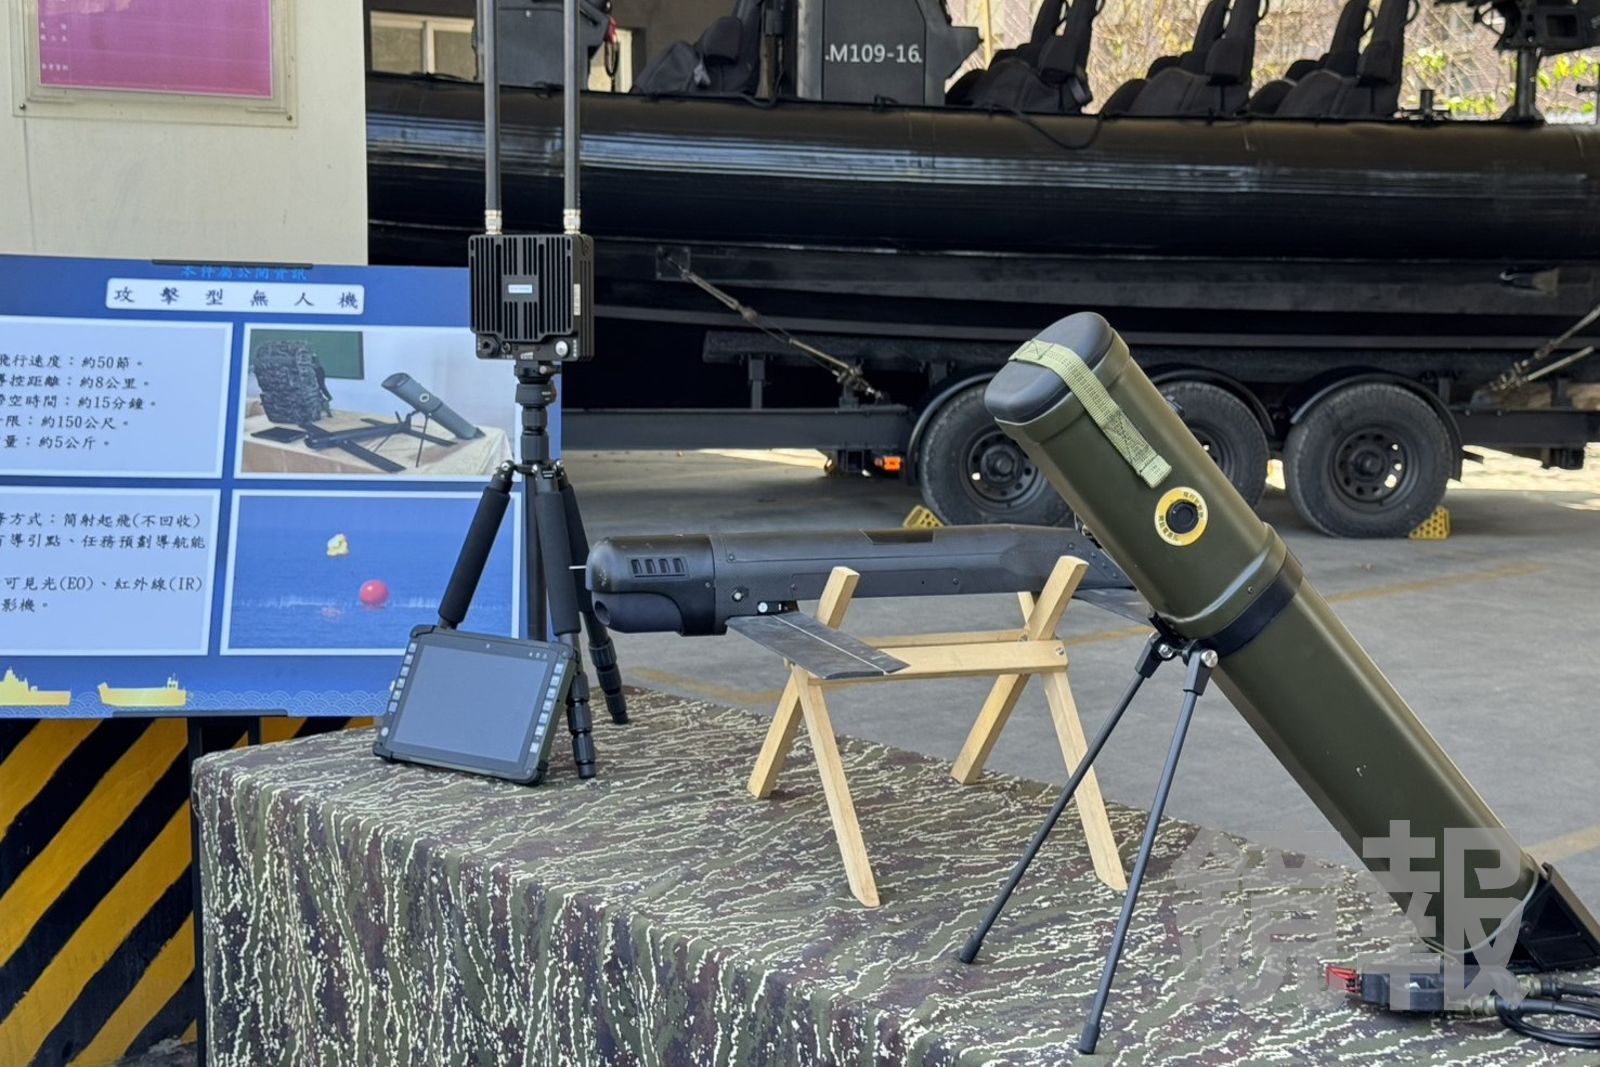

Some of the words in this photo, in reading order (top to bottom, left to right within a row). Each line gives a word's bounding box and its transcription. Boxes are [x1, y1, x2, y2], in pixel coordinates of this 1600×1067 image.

[113, 286, 359, 309] 攻擊型無人機
[0, 414, 129, 430] 限：約150公尺。
